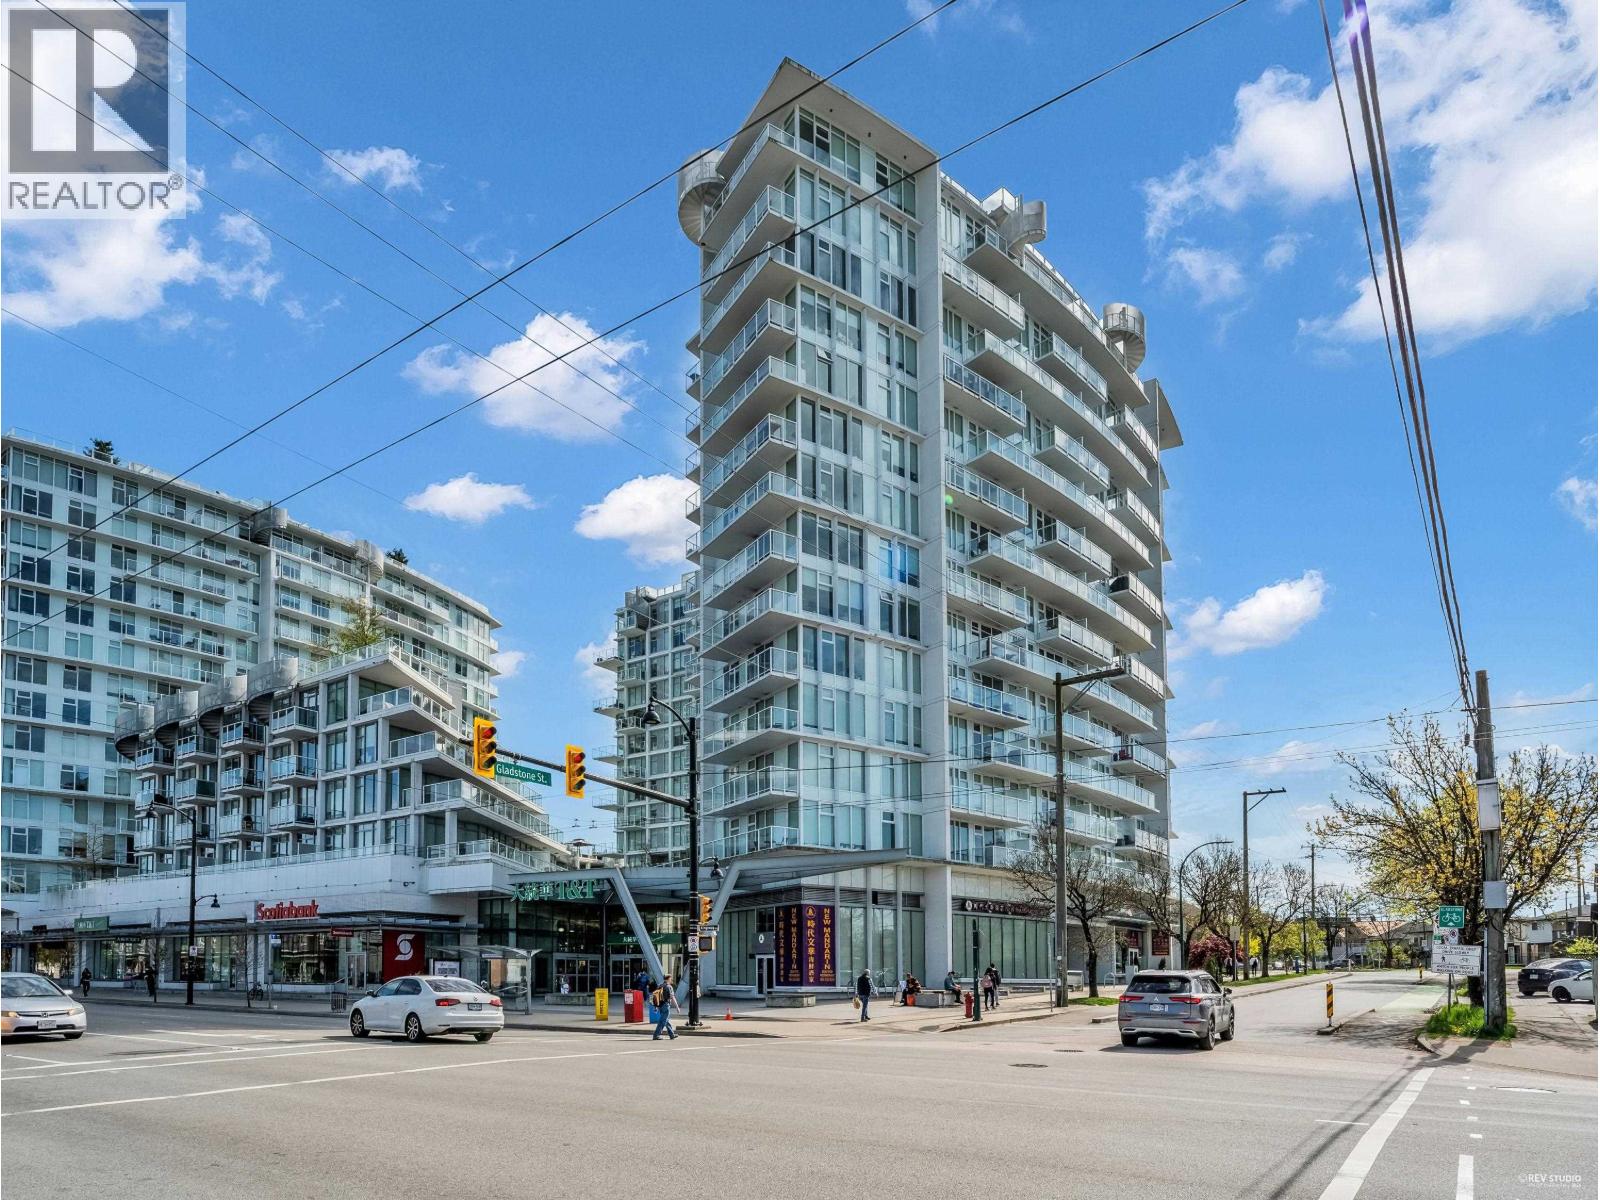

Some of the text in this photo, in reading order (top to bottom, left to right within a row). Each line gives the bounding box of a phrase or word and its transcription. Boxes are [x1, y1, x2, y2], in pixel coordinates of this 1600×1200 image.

[496, 764, 547, 783] Gladstone St.
[555, 879, 597, 900] T&T
[256, 899, 319, 920] Scotiabank
[823, 908, 831, 925] NEW
